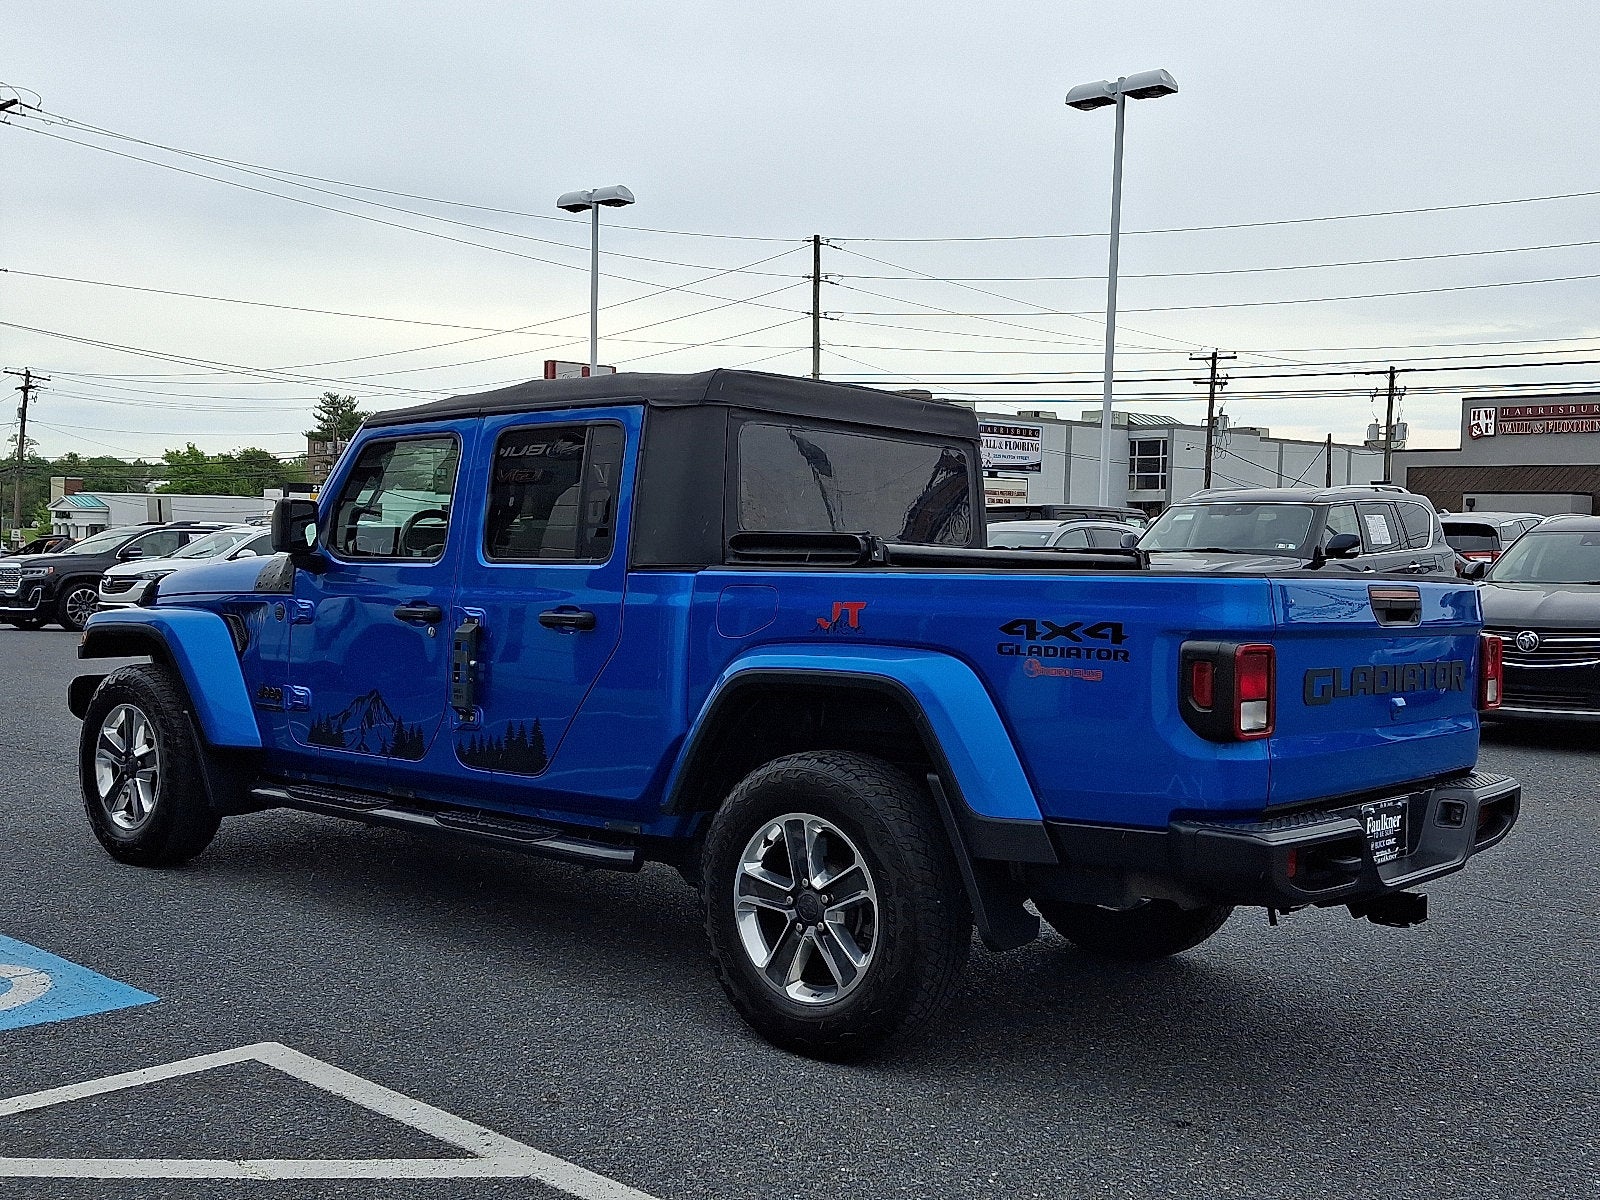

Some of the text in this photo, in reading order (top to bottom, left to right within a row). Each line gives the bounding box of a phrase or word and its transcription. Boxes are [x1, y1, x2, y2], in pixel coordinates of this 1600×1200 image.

[981, 426, 1039, 436] HARRISBURG
[1499, 421, 1531, 434] WALL
[1533, 424, 1543, 434] &
[998, 441, 1003, 449] &
[1004, 441, 1040, 452] FLOORING
[816, 601, 867, 630] JT
[997, 642, 1130, 662] GLADIATOR
[1303, 660, 1465, 706] GLADIATOR
[1366, 814, 1401, 834] Faulkner
